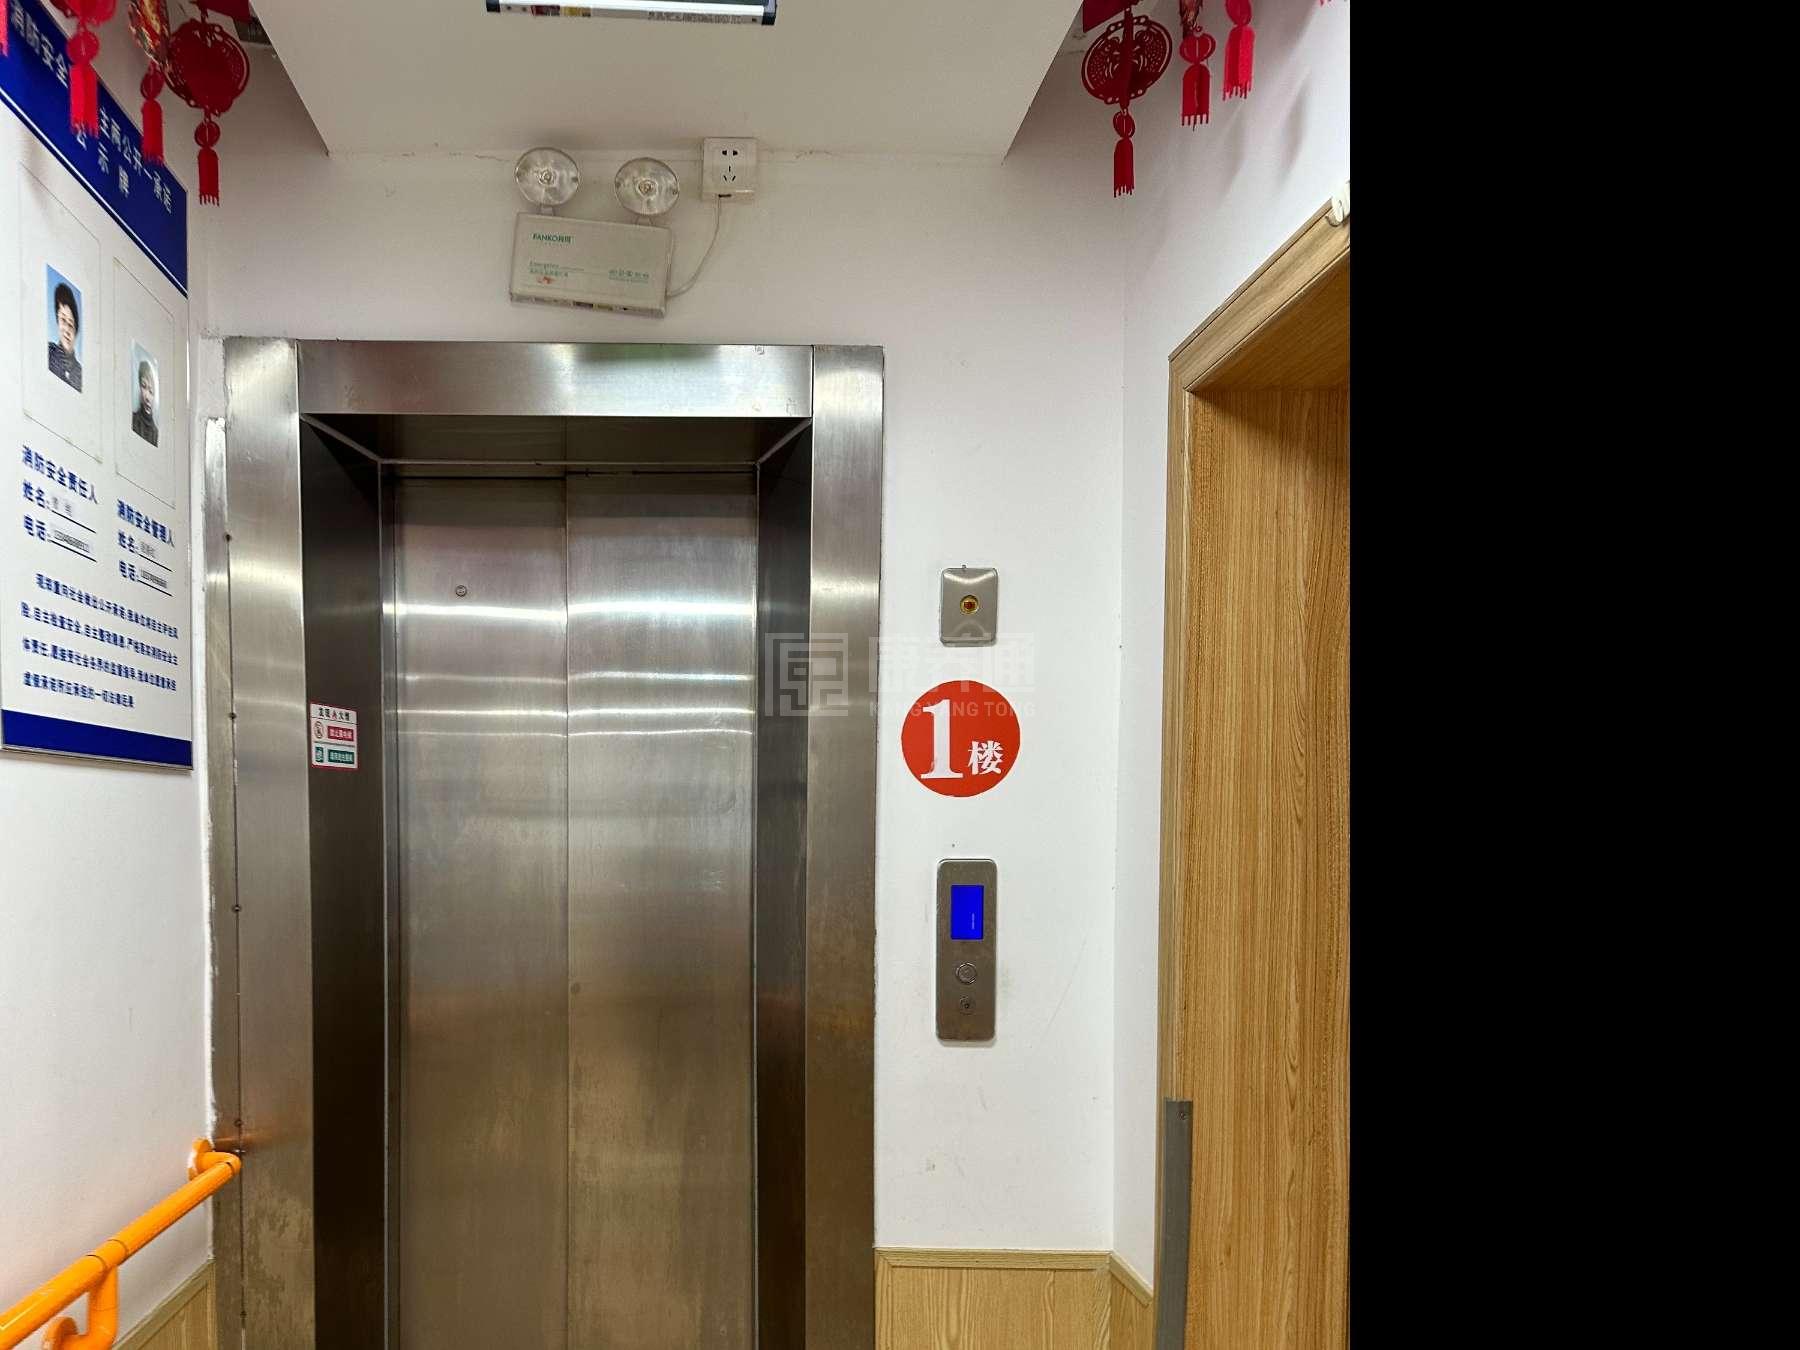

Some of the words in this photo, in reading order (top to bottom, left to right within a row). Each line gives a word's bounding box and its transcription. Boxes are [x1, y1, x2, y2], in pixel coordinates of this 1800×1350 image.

[22, 445, 98, 504] 消防安全责任人
[117, 498, 175, 548] 消防安全管理人
